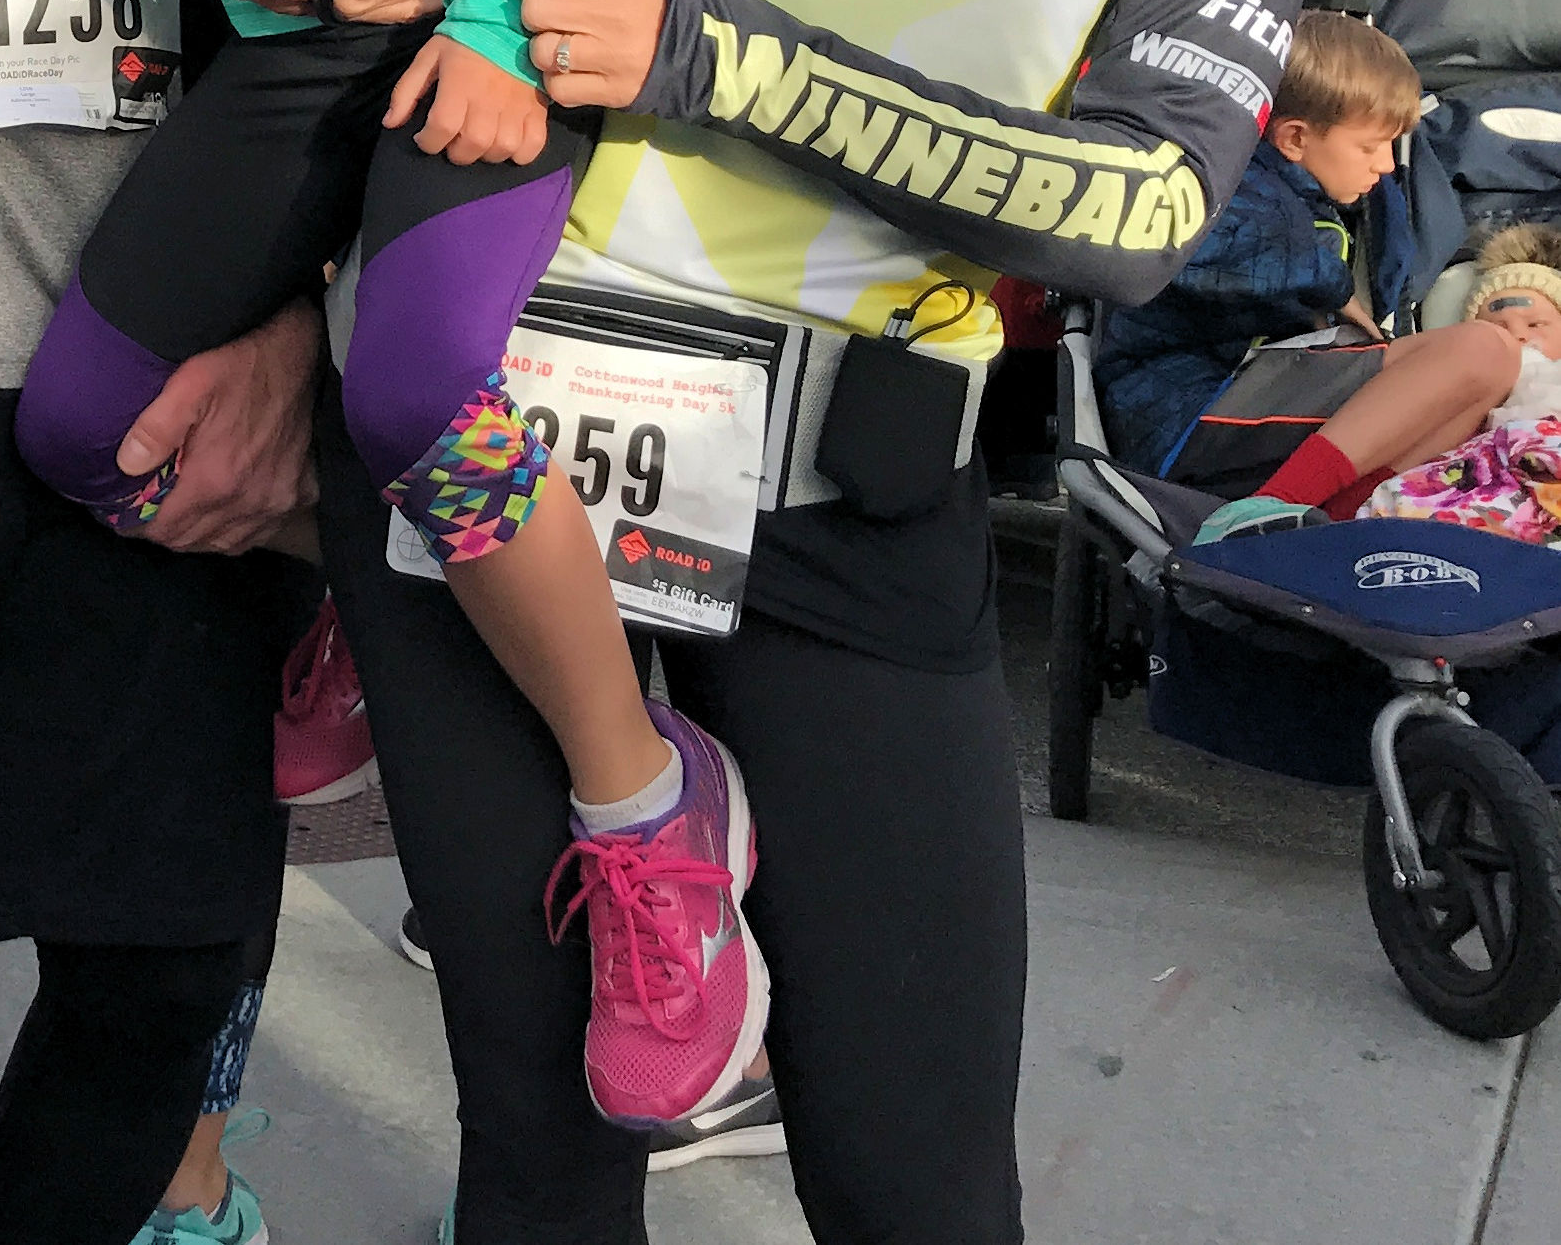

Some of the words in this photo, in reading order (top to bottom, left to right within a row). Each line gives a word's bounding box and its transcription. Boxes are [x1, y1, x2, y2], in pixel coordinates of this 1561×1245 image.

[6, 59, 25, 69] your
[27, 57, 48, 66] Race
[51, 56, 66, 66] Day
[68, 55, 80, 63] Pic
[702, 12, 1206, 250] WINNEBAGO
[502, 354, 532, 373] OAD
[536, 361, 553, 377] iD
[574, 365, 665, 389] Cottonwood
[569, 381, 675, 409] Thanksgiving
[682, 396, 710, 413] Day
[718, 403, 736, 415] 5k
[654, 546, 694, 568] ROAD
[652, 578, 668, 595] $5
[670, 585, 697, 604] Gift
[700, 593, 735, 613] Card
